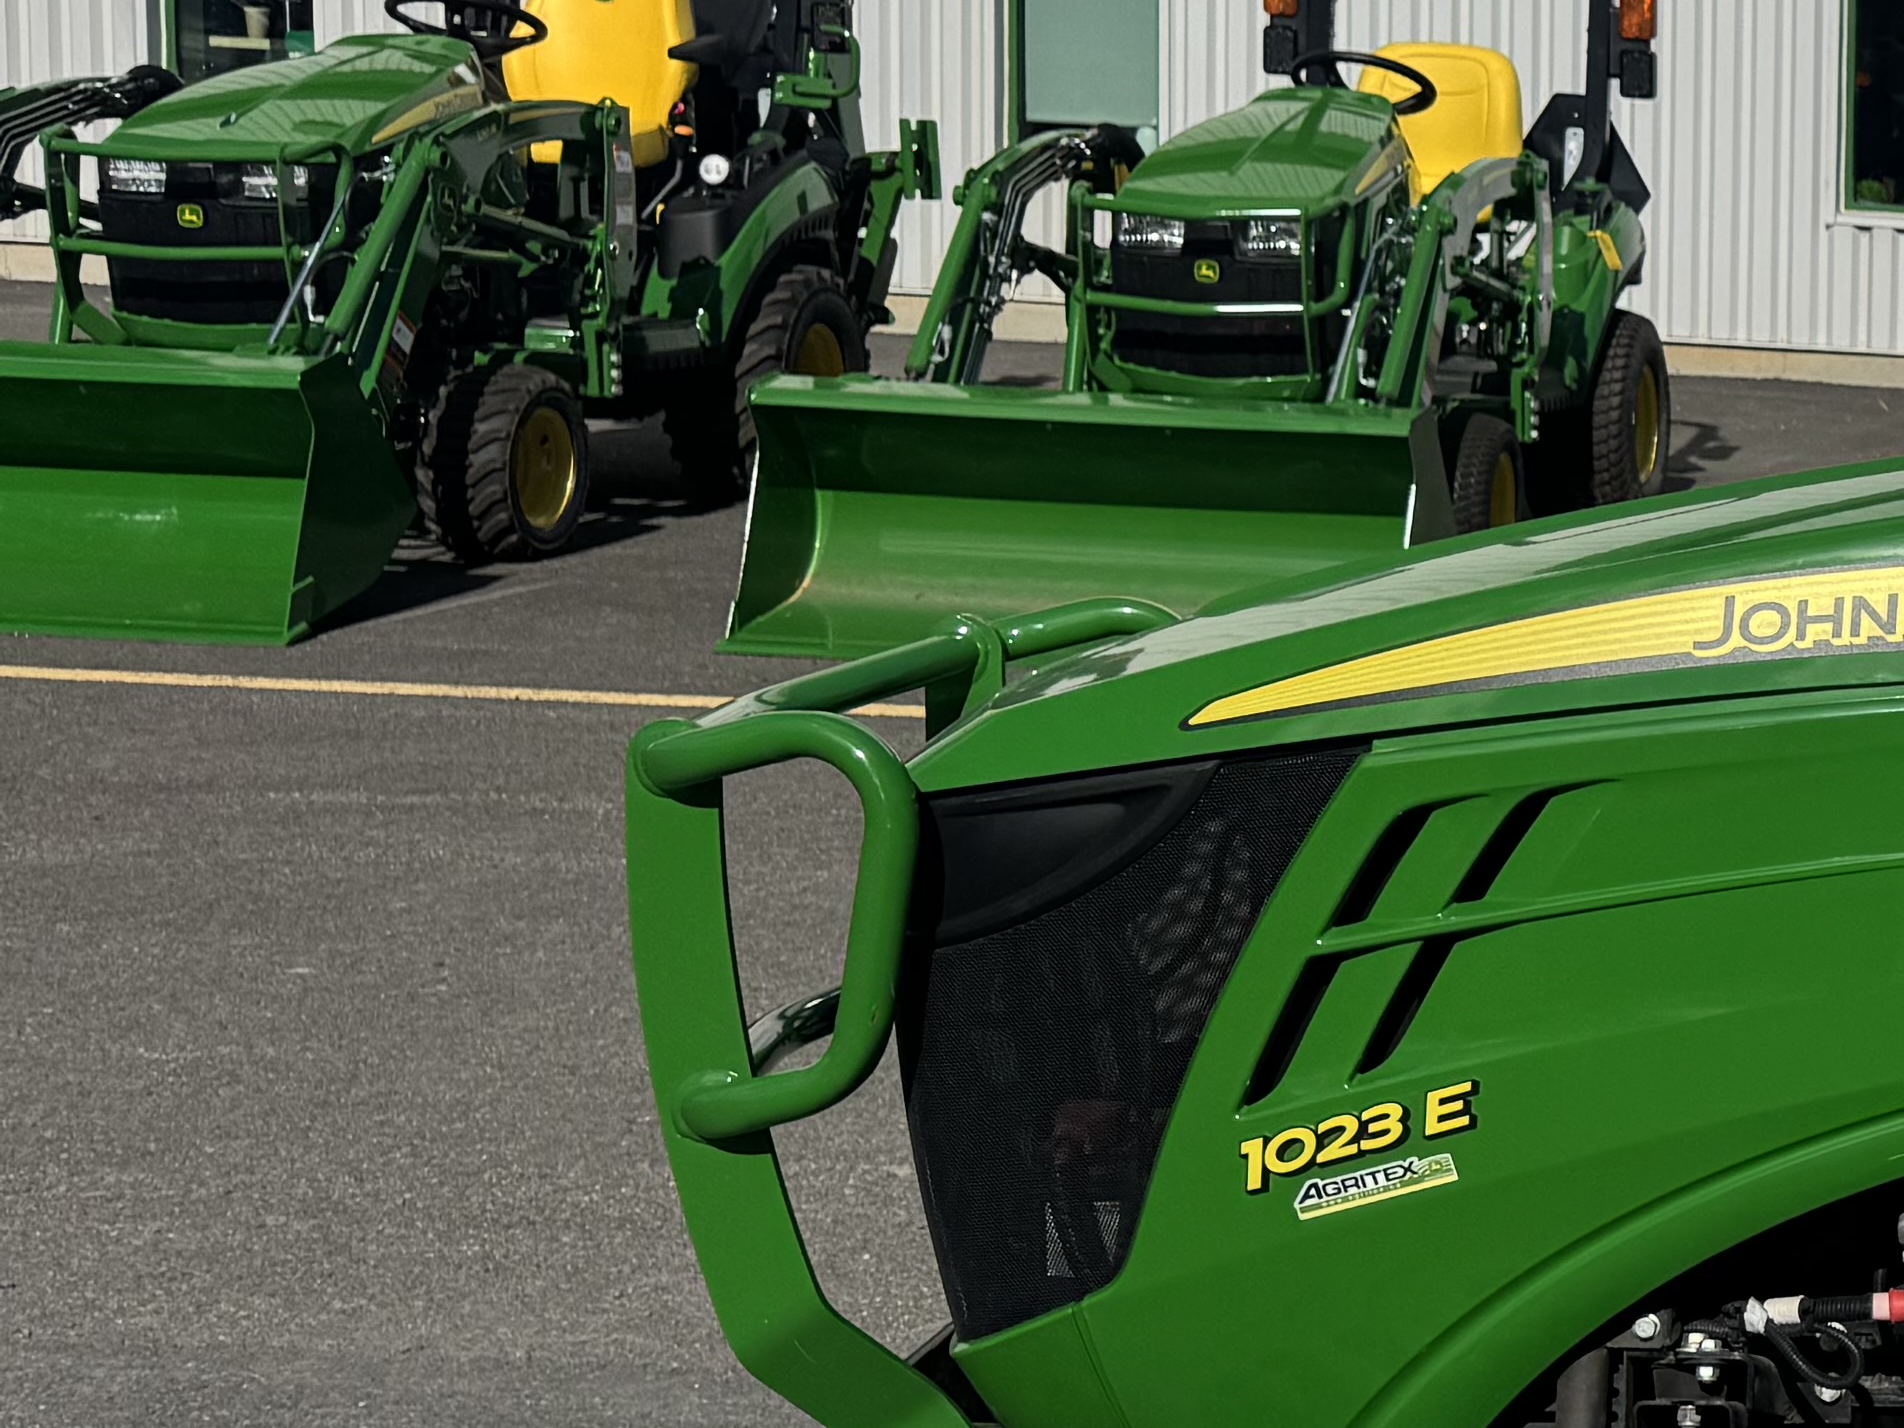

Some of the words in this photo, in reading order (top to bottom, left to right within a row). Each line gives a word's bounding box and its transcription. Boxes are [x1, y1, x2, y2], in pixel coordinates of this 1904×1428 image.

[1692, 593, 1898, 652] JOHN
[1240, 1102, 1408, 1193] 1023
[1425, 1080, 1474, 1138] E
[1298, 1159, 1419, 1206] AGRITEX
